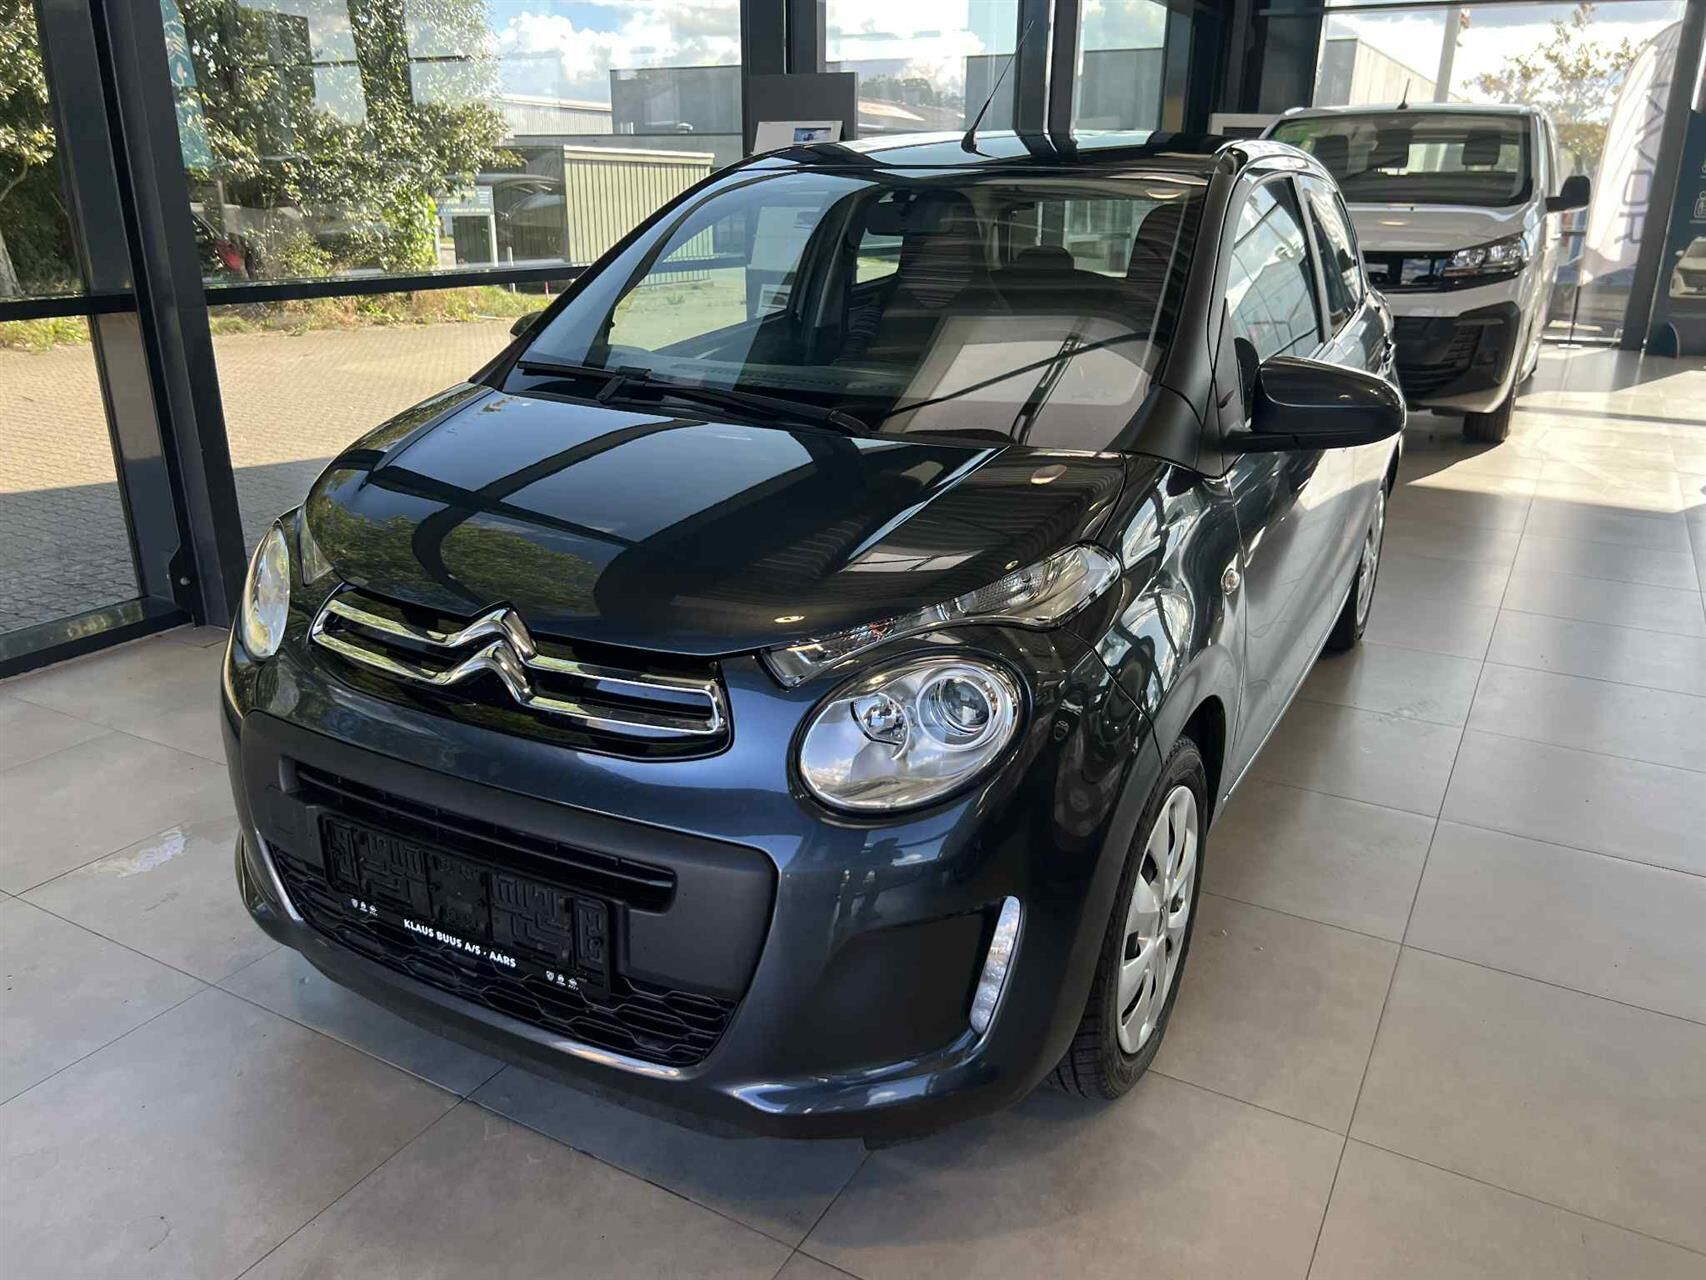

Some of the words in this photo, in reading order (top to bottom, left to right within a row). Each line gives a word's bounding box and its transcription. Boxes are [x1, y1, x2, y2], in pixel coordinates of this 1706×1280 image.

[403, 919, 434, 938] KLAUS
[436, 931, 462, 948] BUUS
[464, 942, 481, 955] A/S
[489, 951, 516, 968] AARS
